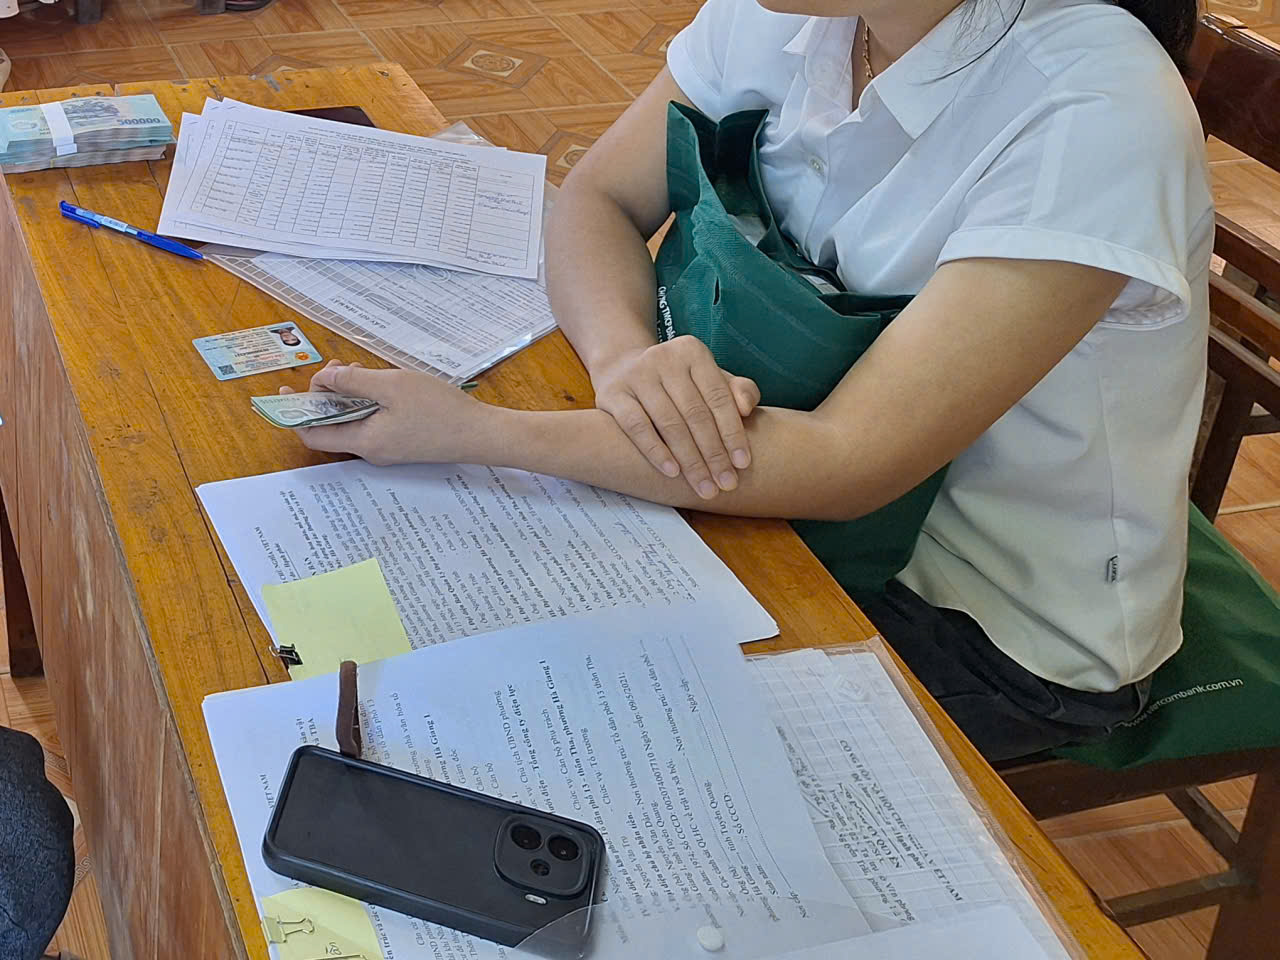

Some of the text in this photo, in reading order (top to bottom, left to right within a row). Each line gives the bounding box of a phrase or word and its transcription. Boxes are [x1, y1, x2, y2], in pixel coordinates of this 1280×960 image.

[117, 115, 161, 127] 500000
[542, 666, 554, 689] Giang
[591, 672, 602, 688] thôn
[506, 684, 516, 696] lực
[494, 690, 509, 720] phường
[511, 699, 521, 716] điện
[599, 701, 613, 715] phố
[685, 694, 698, 712] Ngày
[308, 718, 317, 735] TBA
[556, 704, 573, 735] phường
[607, 716, 617, 730] dân
[663, 708, 679, 734] thường
[427, 720, 438, 744] Giang
[503, 722, 516, 749] UBND
[521, 728, 532, 747] công
[639, 730, 653, 750] Ngày
[673, 736, 684, 750] Nơi
[527, 749, 539, 771] Tổng
[574, 758, 584, 775] thôn
[623, 760, 638, 788] thường
[634, 790, 644, 805] Nơi
[670, 812, 686, 839] CCCD:
[690, 824, 706, 848] QLHC
[741, 866, 755, 883] Giang
